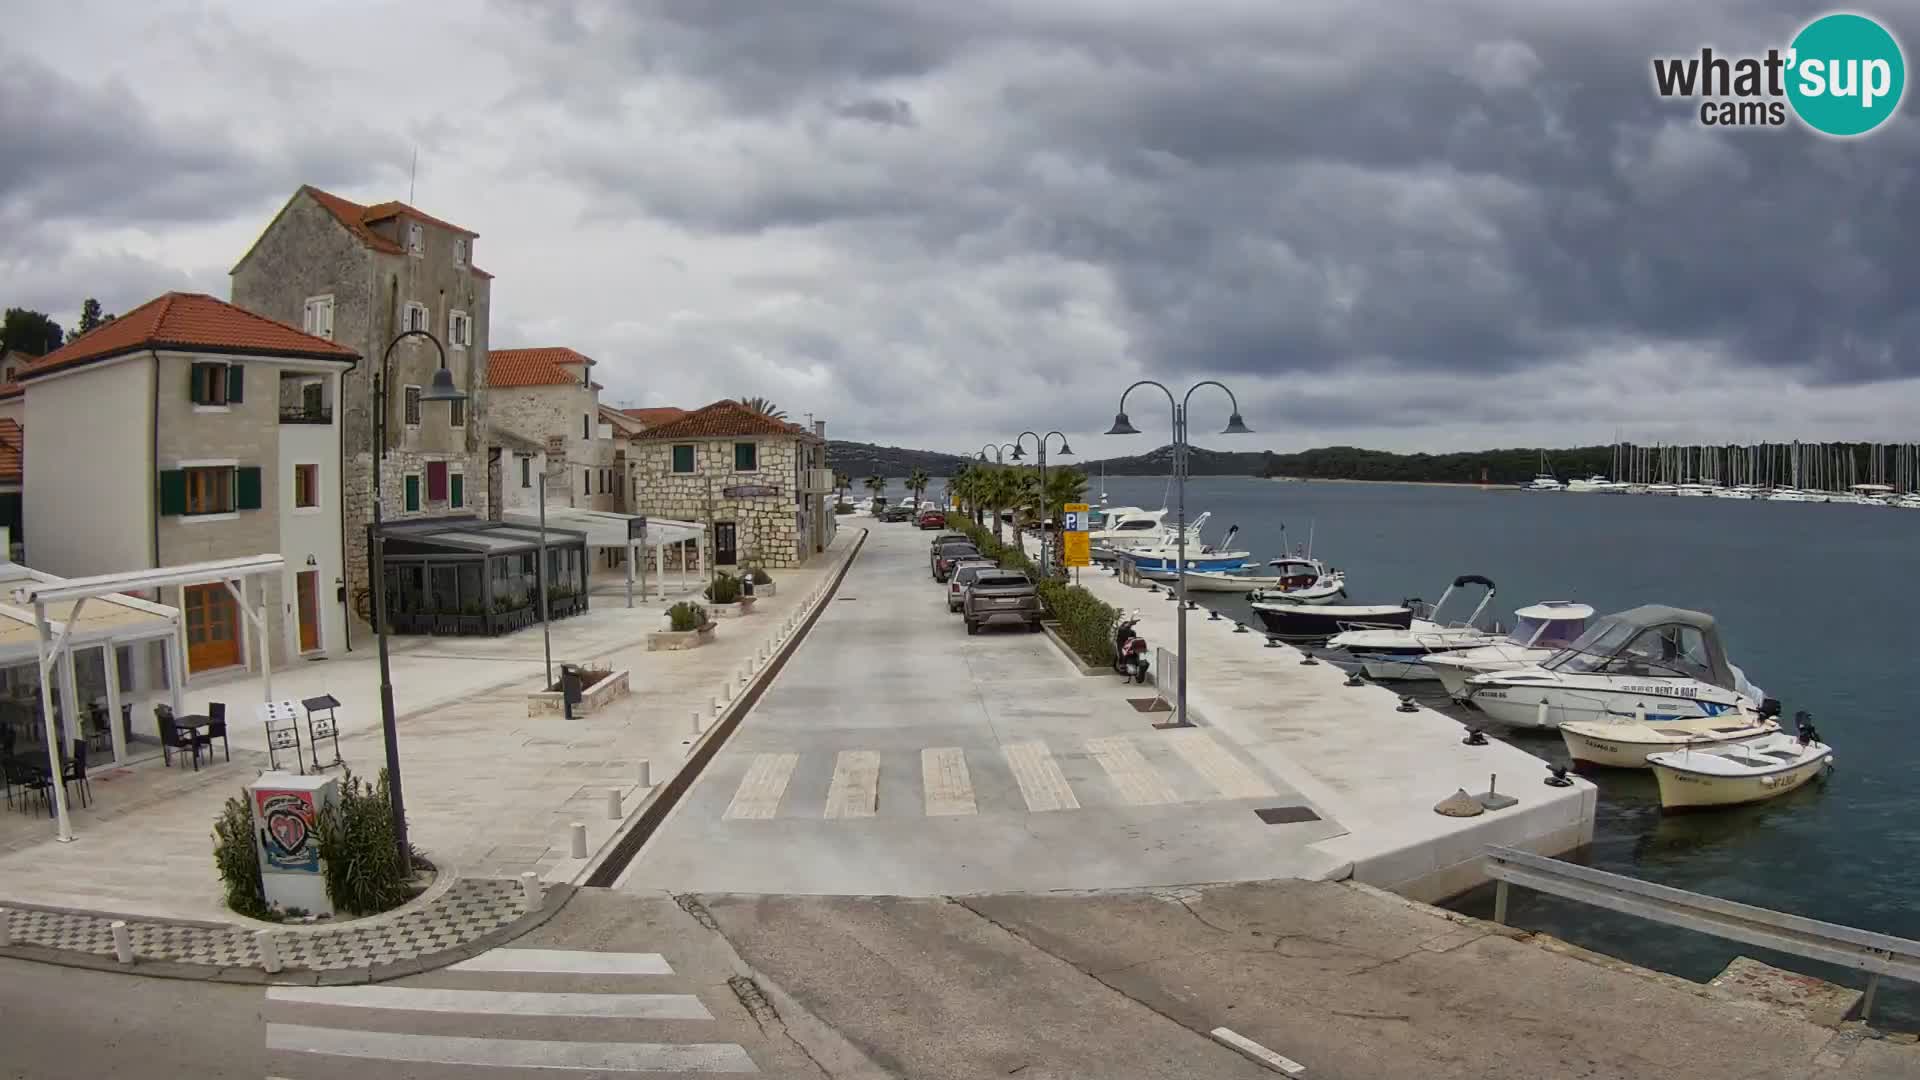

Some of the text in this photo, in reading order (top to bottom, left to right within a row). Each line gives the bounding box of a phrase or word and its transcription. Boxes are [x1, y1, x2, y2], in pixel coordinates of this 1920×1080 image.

[1066, 513, 1076, 529] P
[1655, 686, 1672, 695] RENT
[1674, 687, 1679, 695] A
[1680, 687, 1698, 697] BOAT
